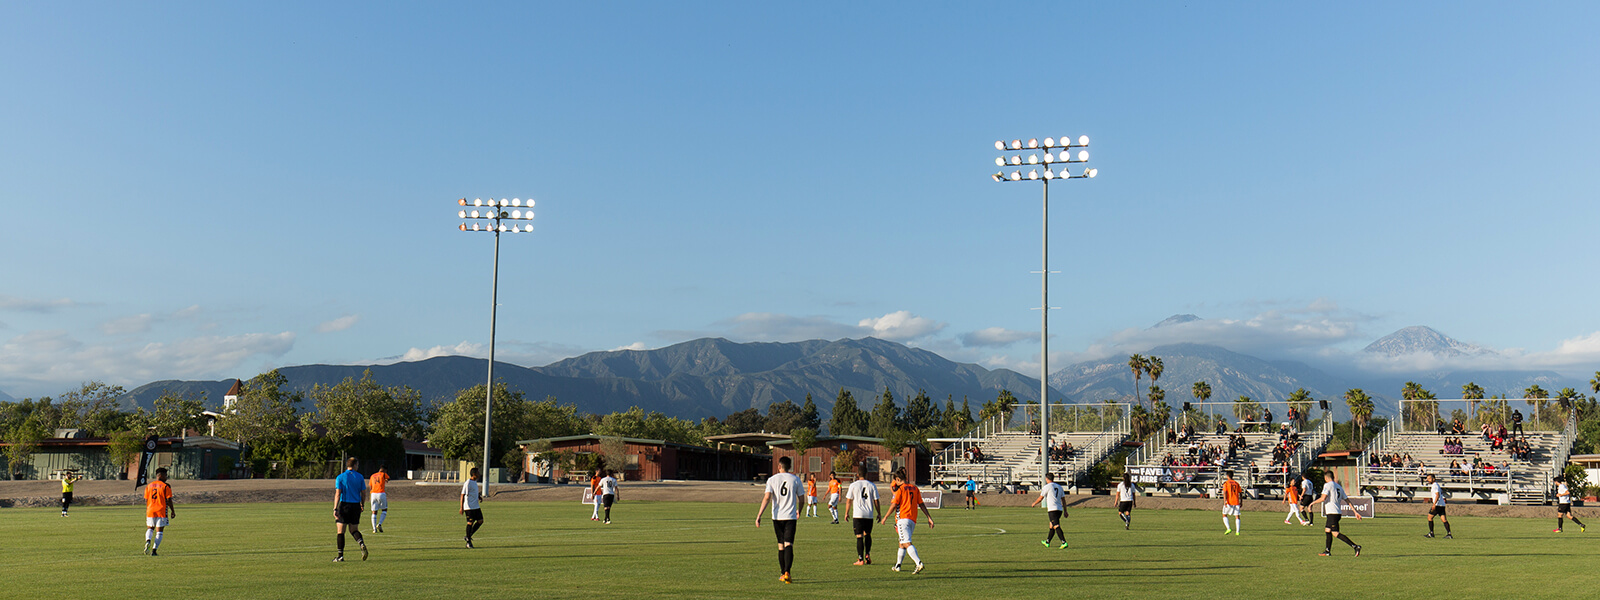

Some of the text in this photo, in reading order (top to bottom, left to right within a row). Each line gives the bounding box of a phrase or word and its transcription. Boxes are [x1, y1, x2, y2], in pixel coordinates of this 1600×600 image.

[1140, 468, 1173, 476] FAVELA
[152, 488, 158, 499] 2
[780, 481, 788, 496] 6
[861, 487, 868, 500] 4
[1054, 487, 1059, 498] 7
[909, 491, 914, 504] 7
